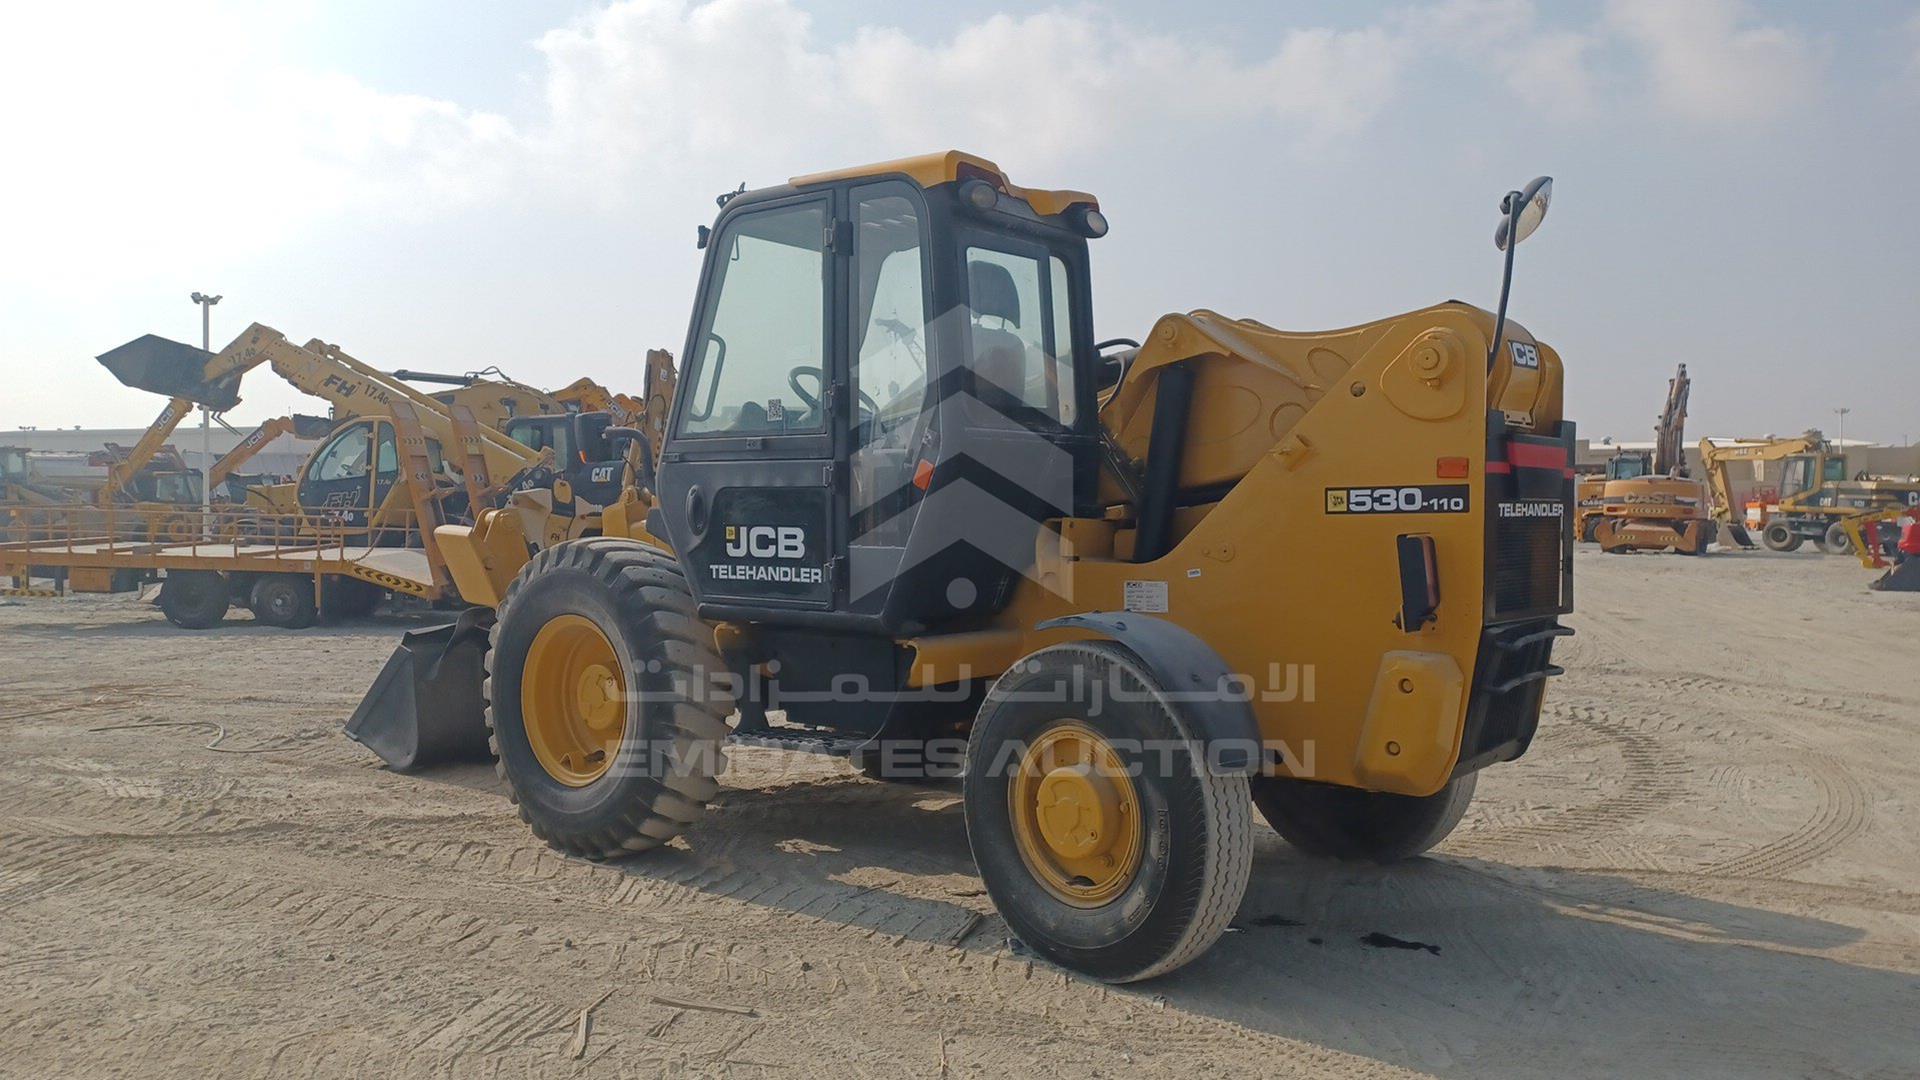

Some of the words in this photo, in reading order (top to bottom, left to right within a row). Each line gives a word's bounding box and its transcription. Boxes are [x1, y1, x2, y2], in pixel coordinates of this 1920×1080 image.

[1512, 341, 1538, 367] CB
[158, 407, 175, 430] JCB
[246, 430, 265, 449] JCB
[591, 467, 613, 483] CAT
[1349, 487, 1464, 512] 530-110
[1624, 491, 1677, 505] CASE
[1498, 502, 1564, 517] TELEHANDLER
[725, 526, 806, 559] JCB
[709, 564, 823, 583] TELEHANDLER
